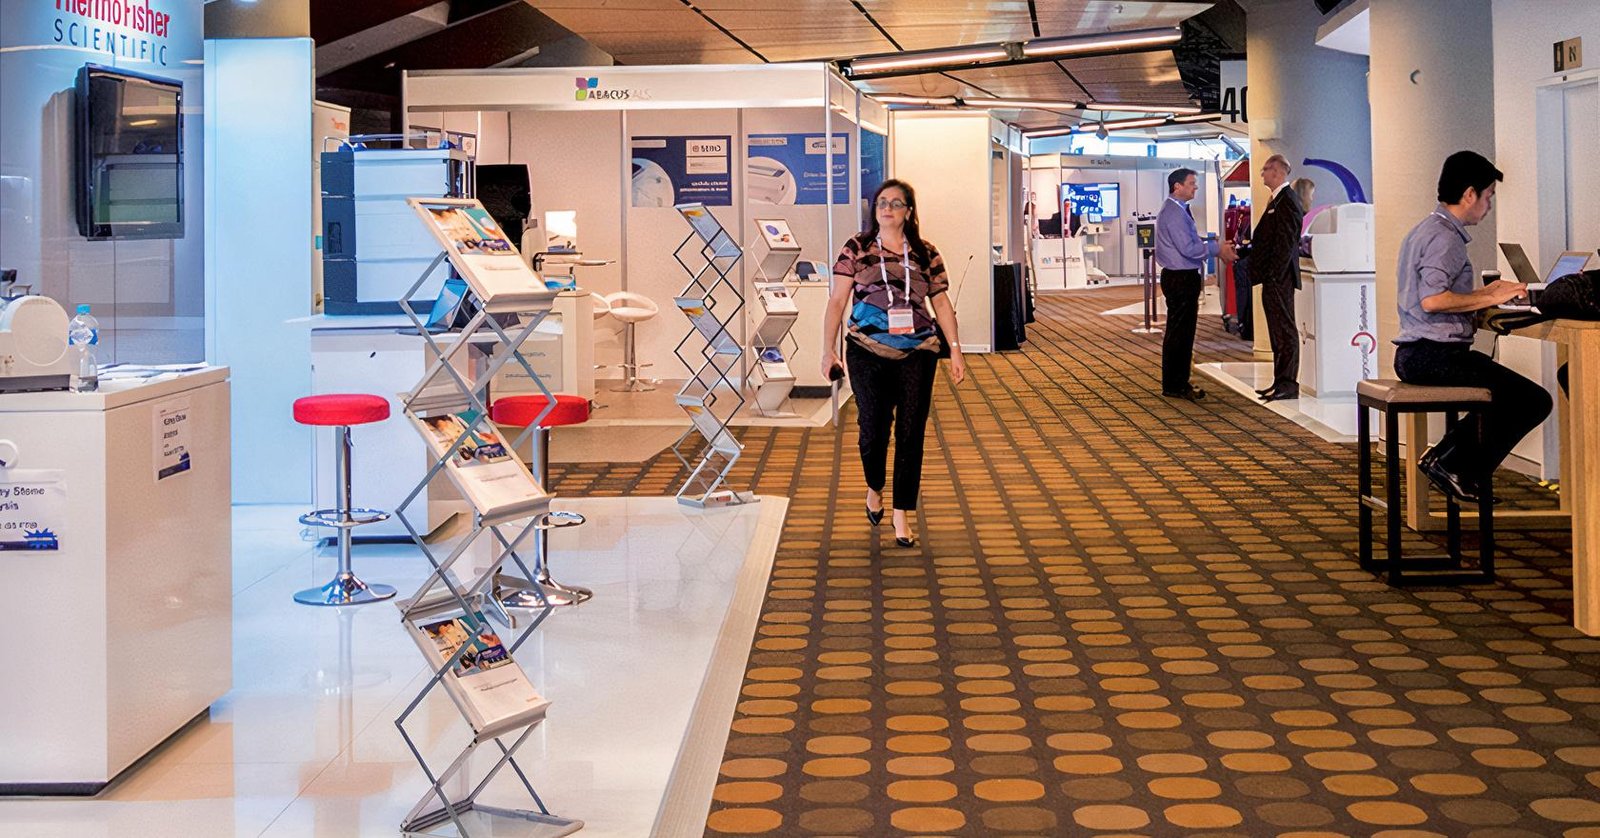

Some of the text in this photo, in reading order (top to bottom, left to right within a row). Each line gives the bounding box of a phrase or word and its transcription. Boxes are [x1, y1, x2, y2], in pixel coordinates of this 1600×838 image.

[56, 0, 170, 38] ermoFisher
[54, 18, 167, 66] SCIENTIFIC
[588, 90, 630, 99] ABACUS
